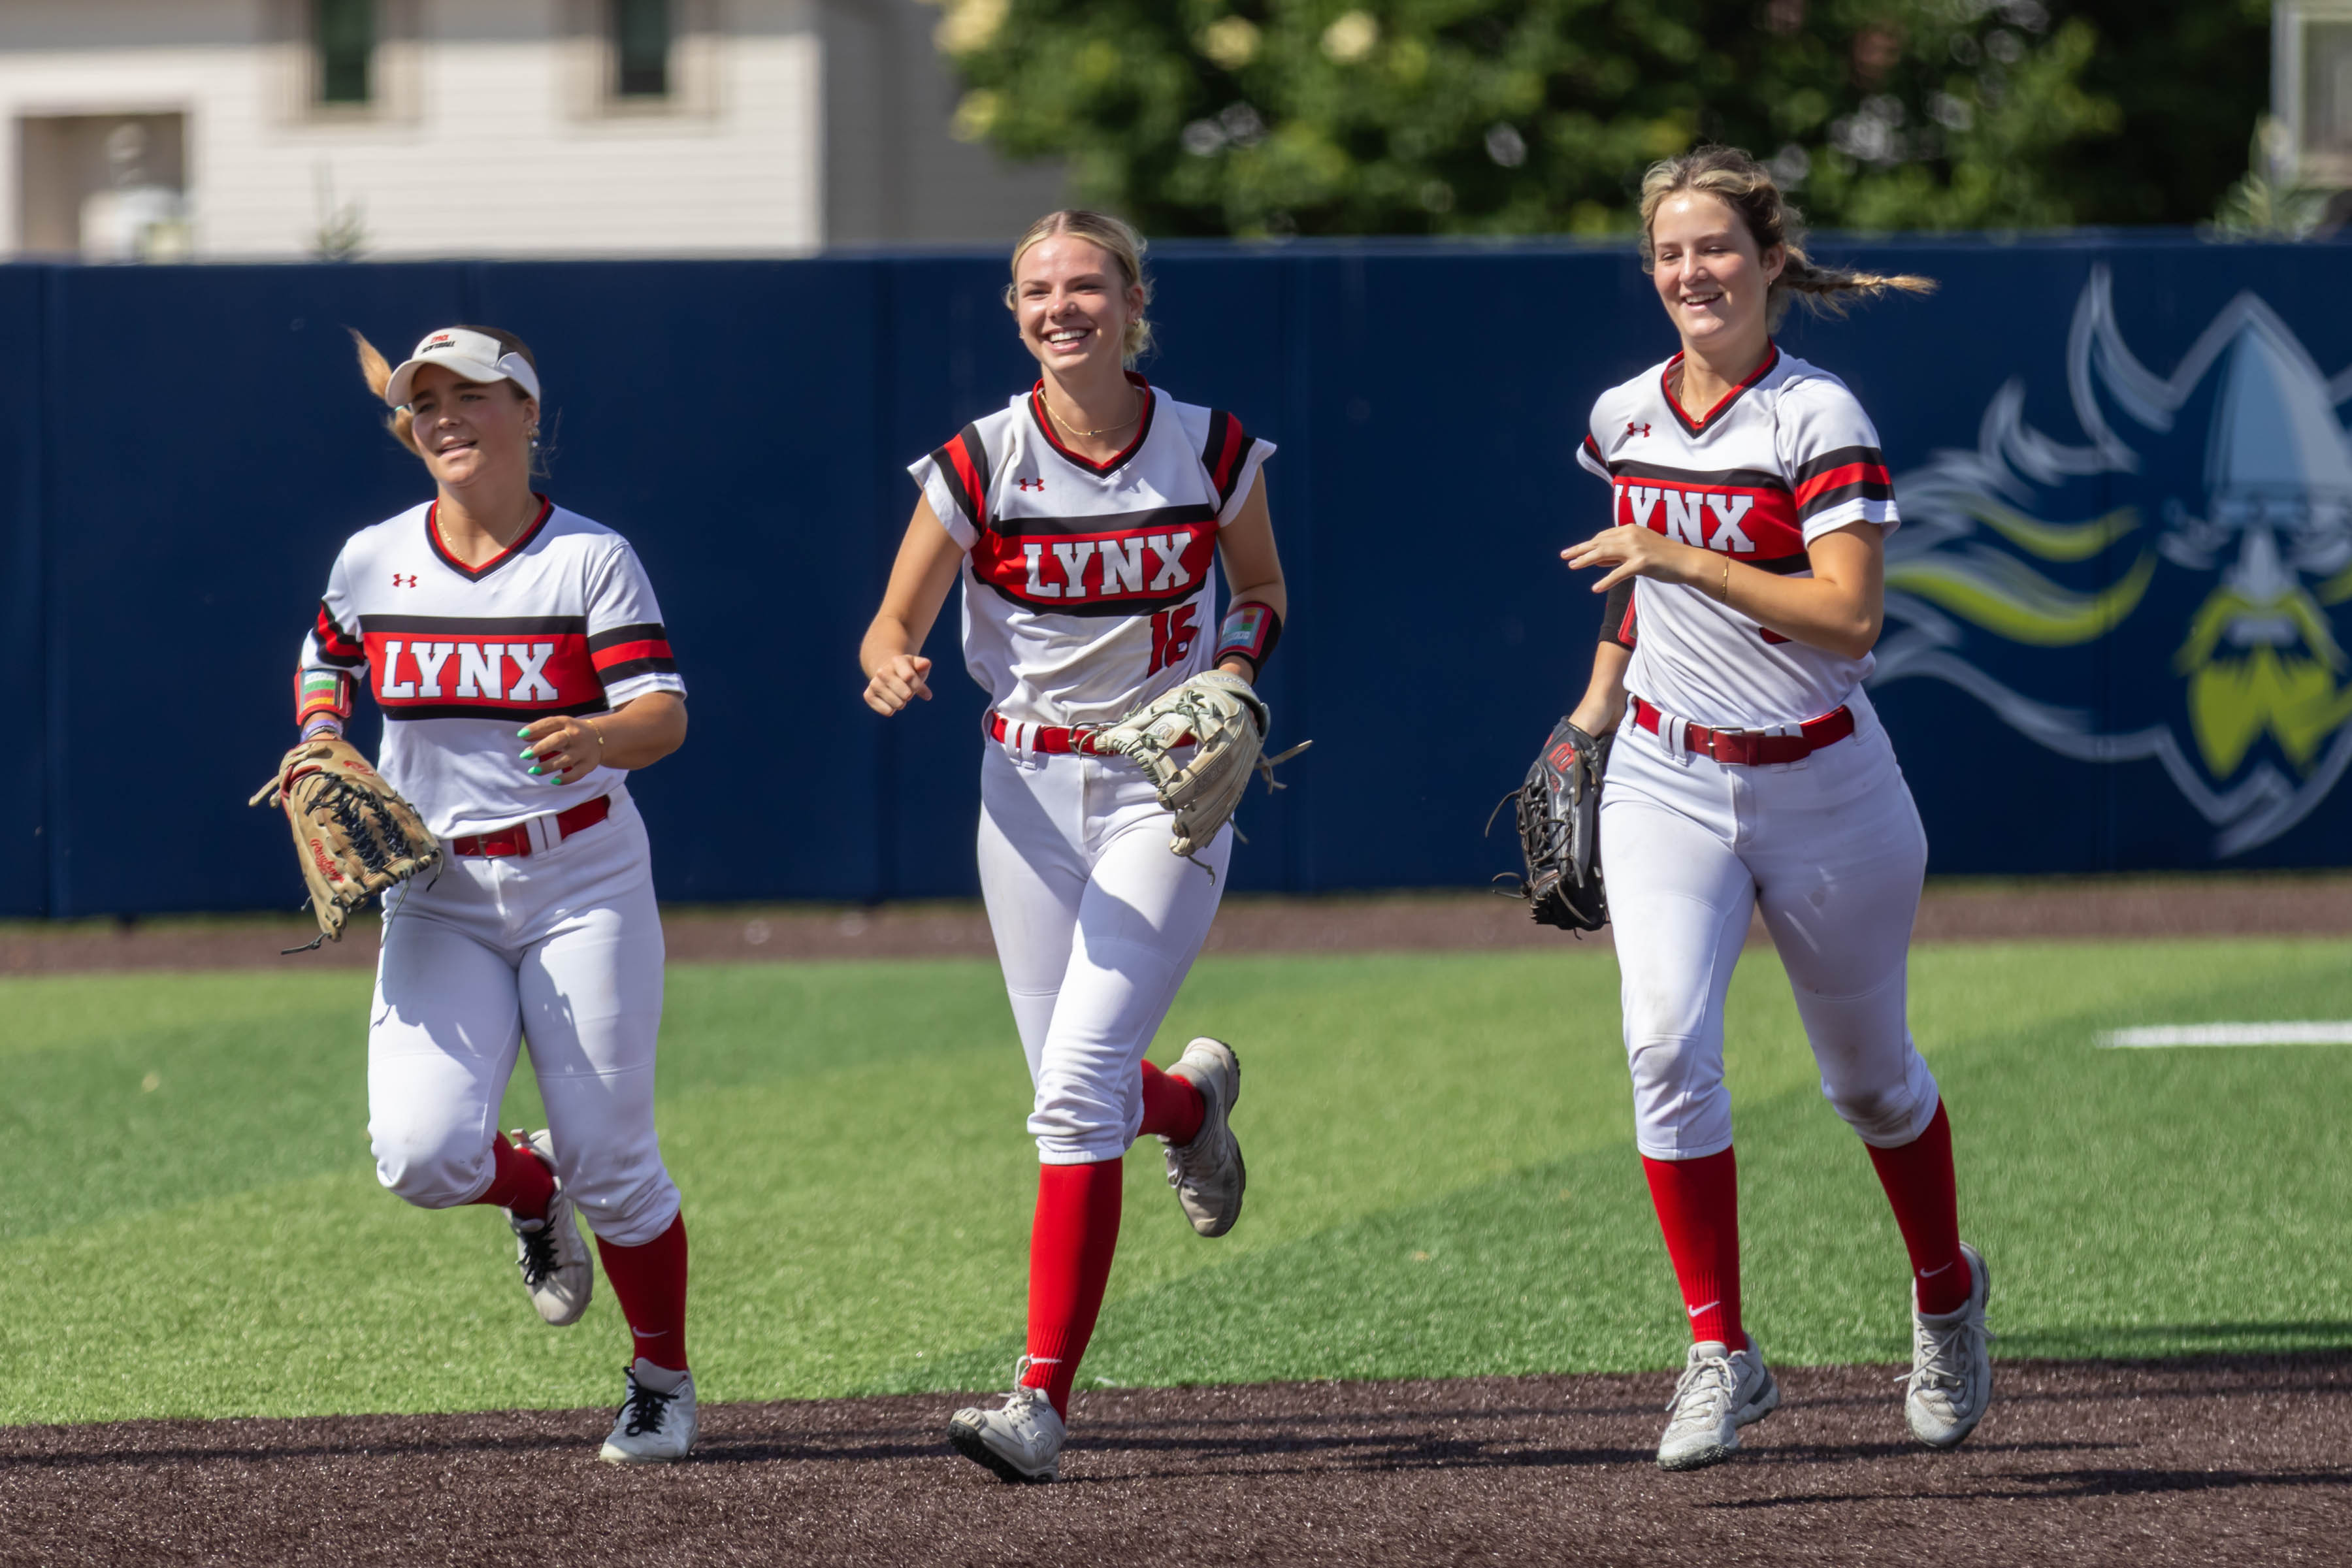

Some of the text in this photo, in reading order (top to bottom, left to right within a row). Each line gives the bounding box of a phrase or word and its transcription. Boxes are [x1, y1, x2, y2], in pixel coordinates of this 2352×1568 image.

[1022, 531, 1192, 598] LYNX
[381, 640, 559, 702] LYNX
[1146, 601, 1198, 679] 16
